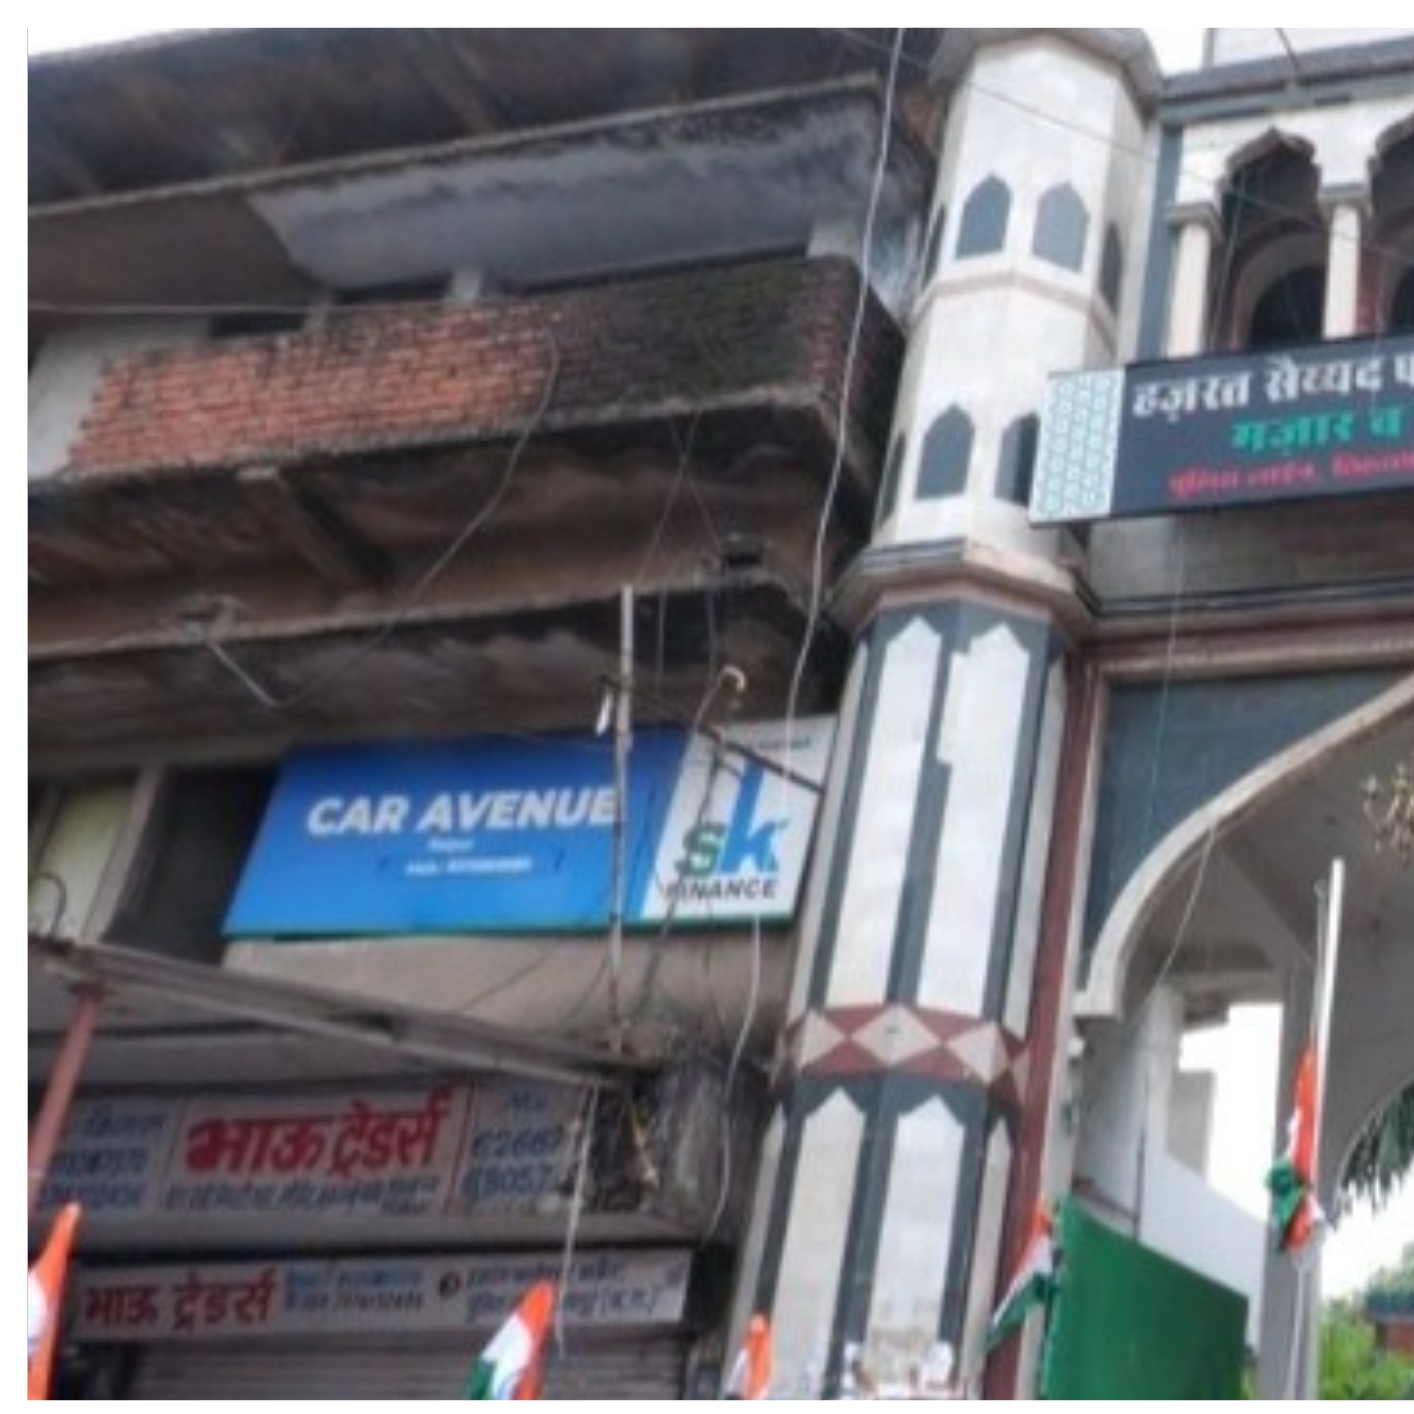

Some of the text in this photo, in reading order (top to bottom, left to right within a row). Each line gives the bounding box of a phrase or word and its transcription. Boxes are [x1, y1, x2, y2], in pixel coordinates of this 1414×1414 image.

[1368, 403, 1403, 440] व
[307, 787, 623, 836] CAR AVENUE
[184, 1084, 451, 1178] भाऊ ट्रेडर्स
[84, 1285, 160, 1327] भाऊ
[168, 1260, 278, 1333] ट्रेडर्स
